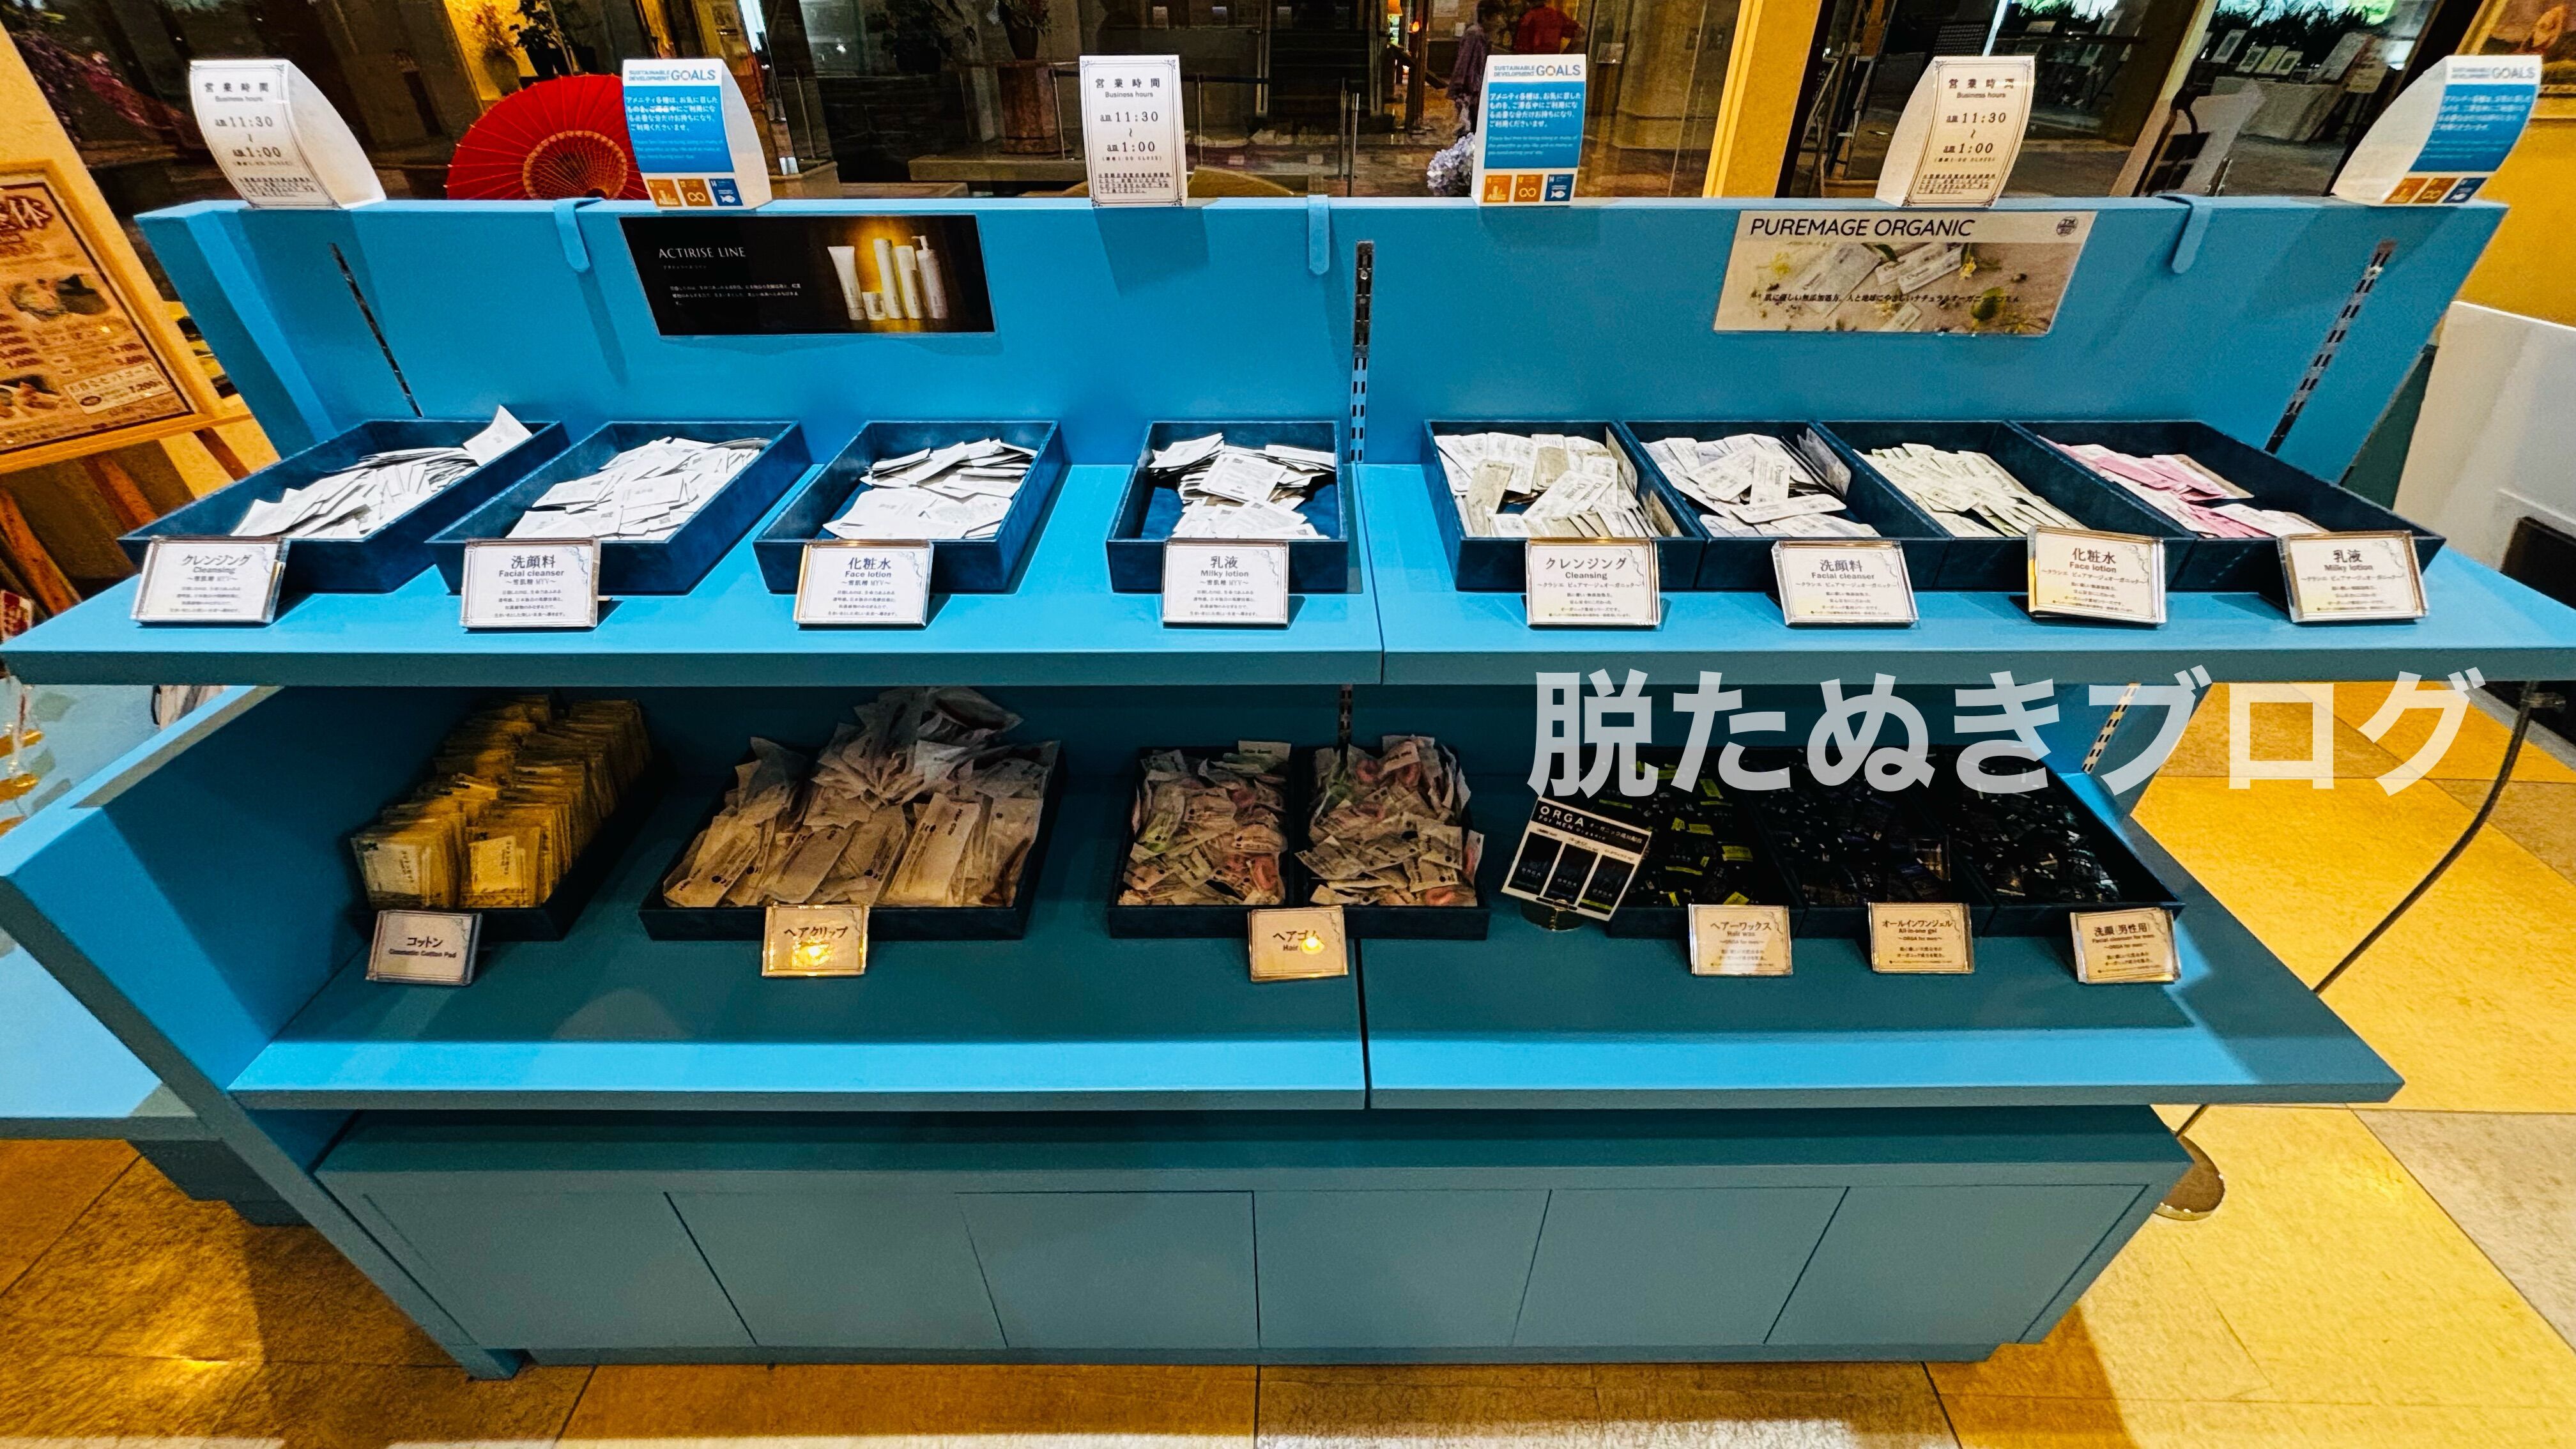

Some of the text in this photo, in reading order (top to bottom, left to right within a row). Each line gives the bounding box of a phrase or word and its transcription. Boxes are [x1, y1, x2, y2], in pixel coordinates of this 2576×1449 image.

[671, 70, 716, 81] GOALS
[1536, 65, 1581, 76] GOALS
[2492, 66, 2536, 79] GOALS
[1095, 78, 1160, 88] 営業時間
[1750, 218, 1976, 237] PUREMAGE ORGANIC
[659, 247, 746, 259] ACTIRISE LINE
[181, 554, 252, 566] クレンジング
[511, 555, 556, 569] 洗顔料
[2072, 548, 2116, 564] 化粧水
[2333, 549, 2363, 563] 乳液
[848, 557, 892, 570] 化粧水
[1210, 556, 1238, 569] 乳液
[1545, 557, 1627, 570] クレンジング
[1820, 559, 1862, 572] 洗顔料
[2069, 562, 2117, 573] Face lotion
[1565, 572, 1608, 580] Cleansing
[1540, 806, 1584, 827] ORGA
[783, 926, 848, 938] ヘアクリップ
[1710, 921, 1772, 931] ヘアーワックス
[407, 936, 443, 948] コットン
